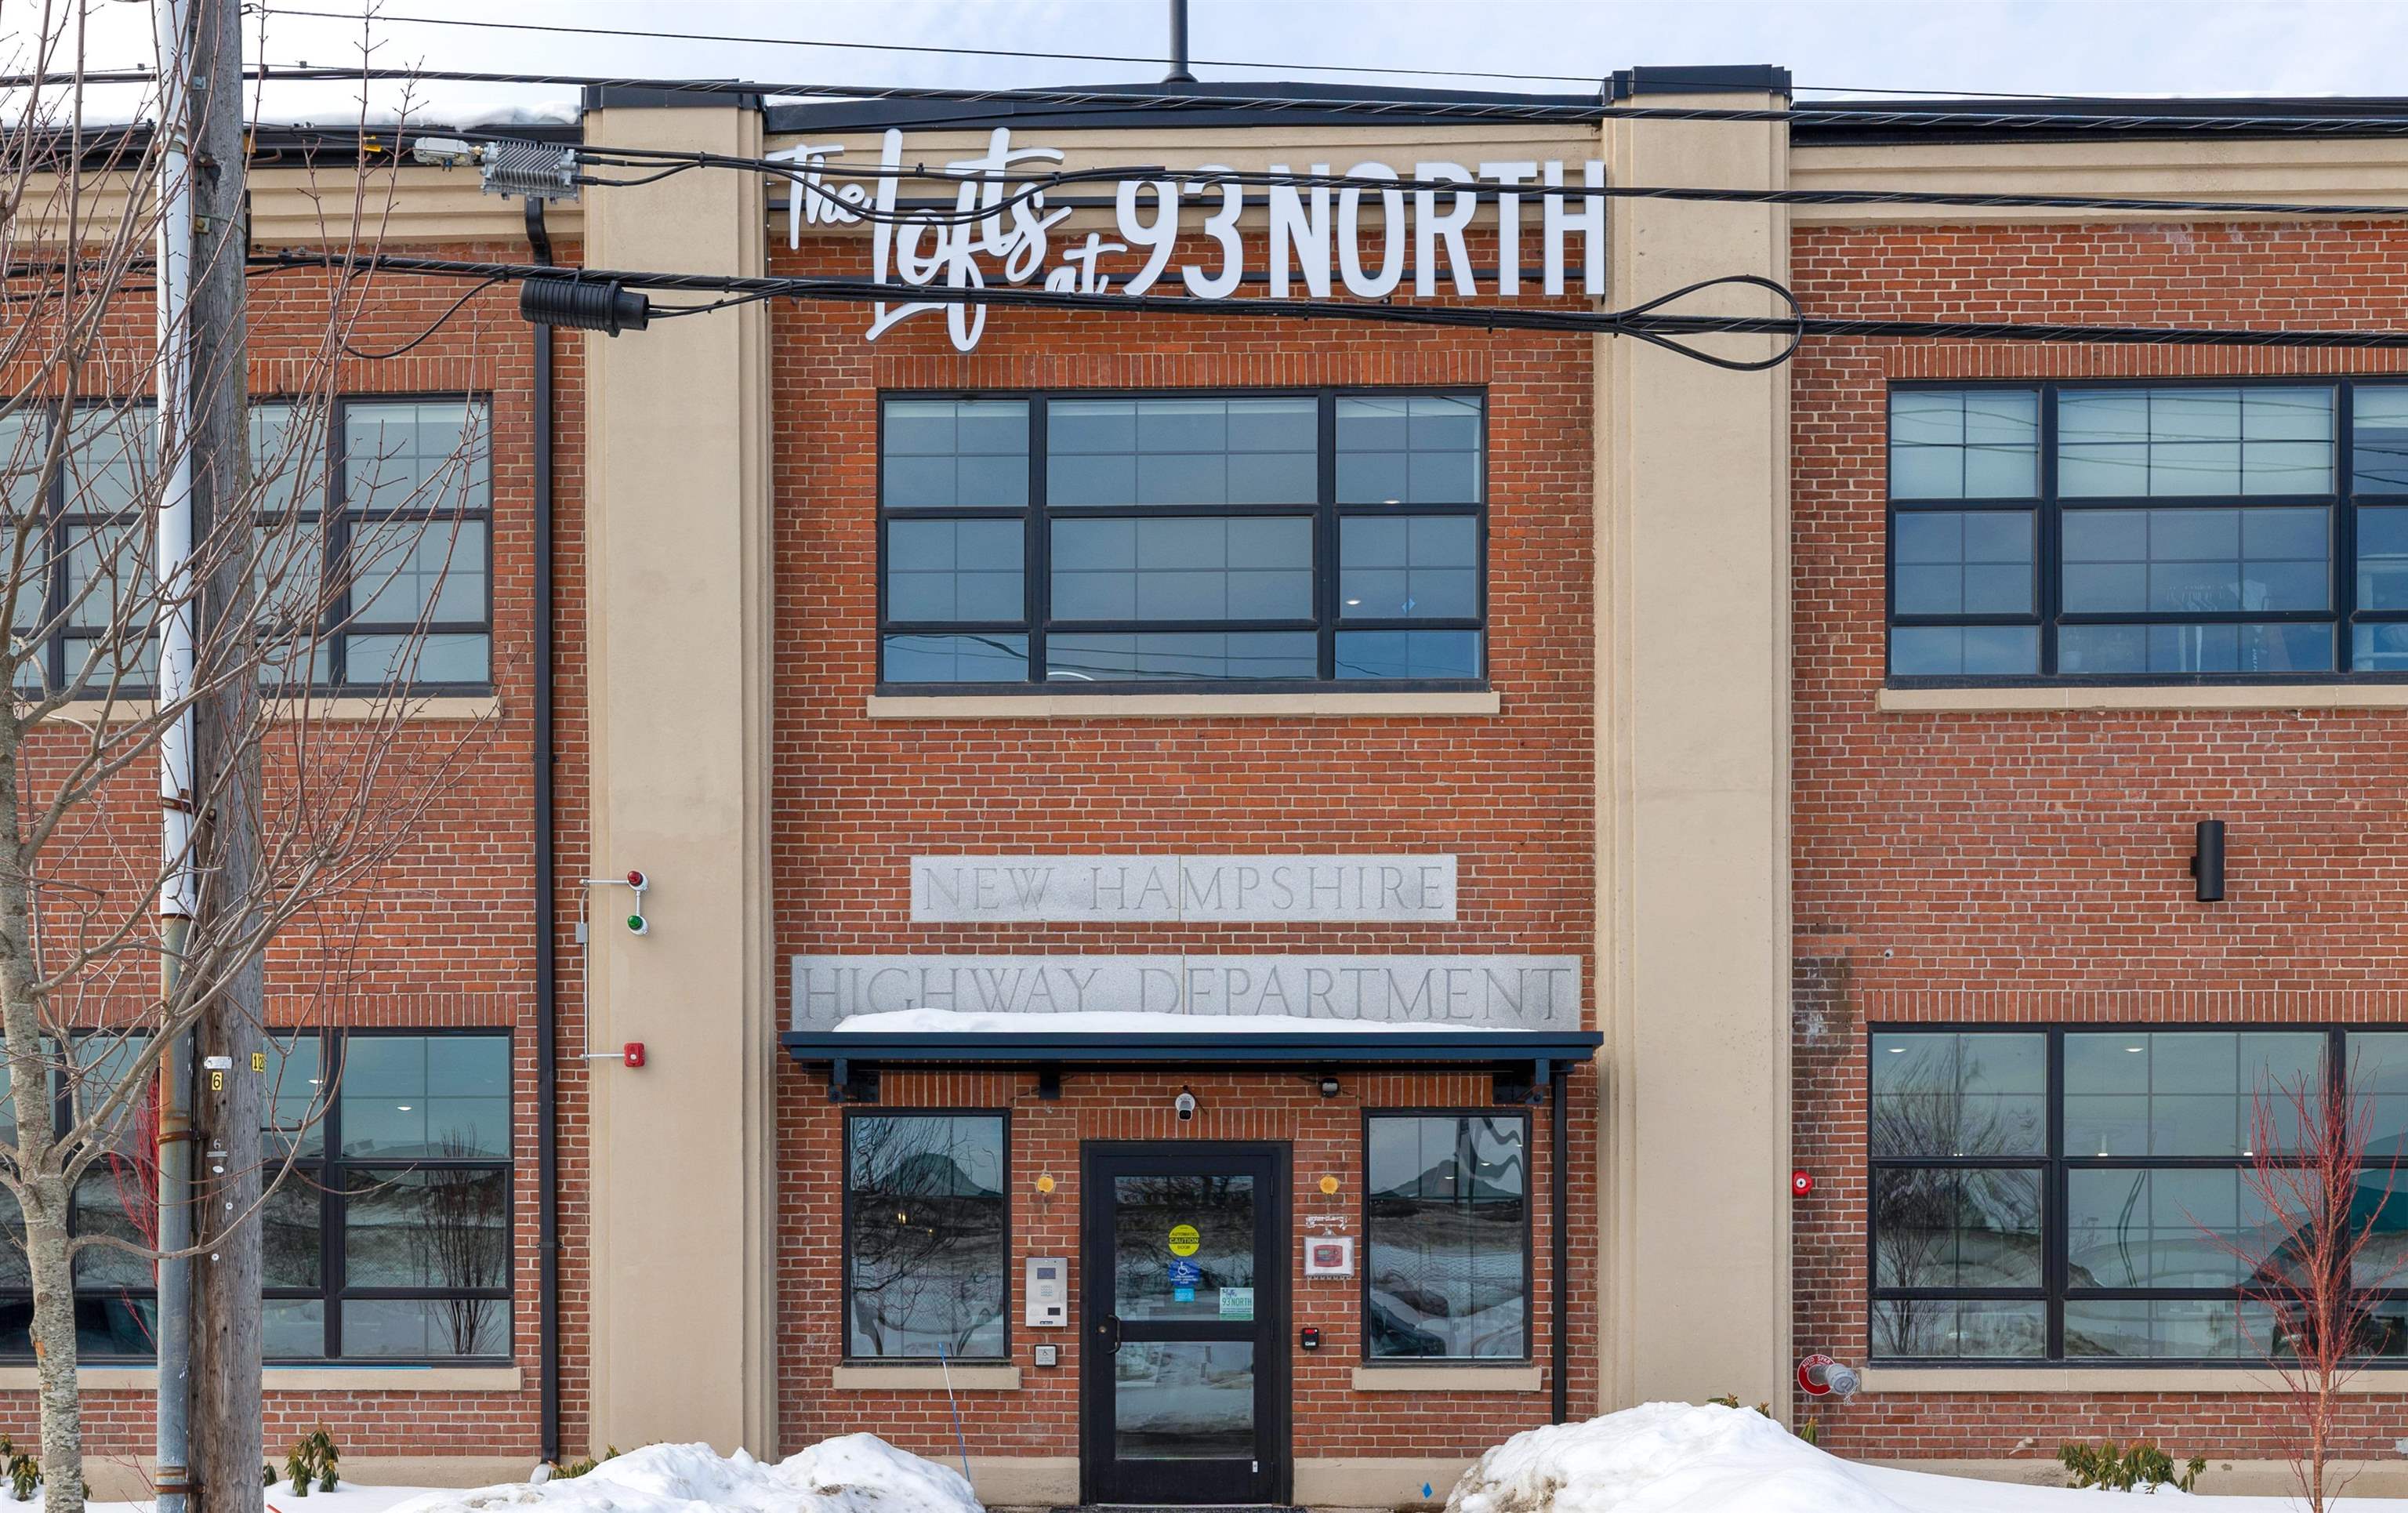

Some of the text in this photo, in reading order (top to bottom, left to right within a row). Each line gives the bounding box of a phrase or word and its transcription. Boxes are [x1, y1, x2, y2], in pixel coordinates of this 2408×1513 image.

[765, 127, 1605, 352] The Lofts at 93 NORTH
[921, 865, 1445, 912] NEW HAMPSHIRE
[802, 965, 1572, 1021] HIGHWAY DEPARTMENT
[213, 1074, 221, 1088] 6
[1222, 1297, 1252, 1306] 93 NORTH
